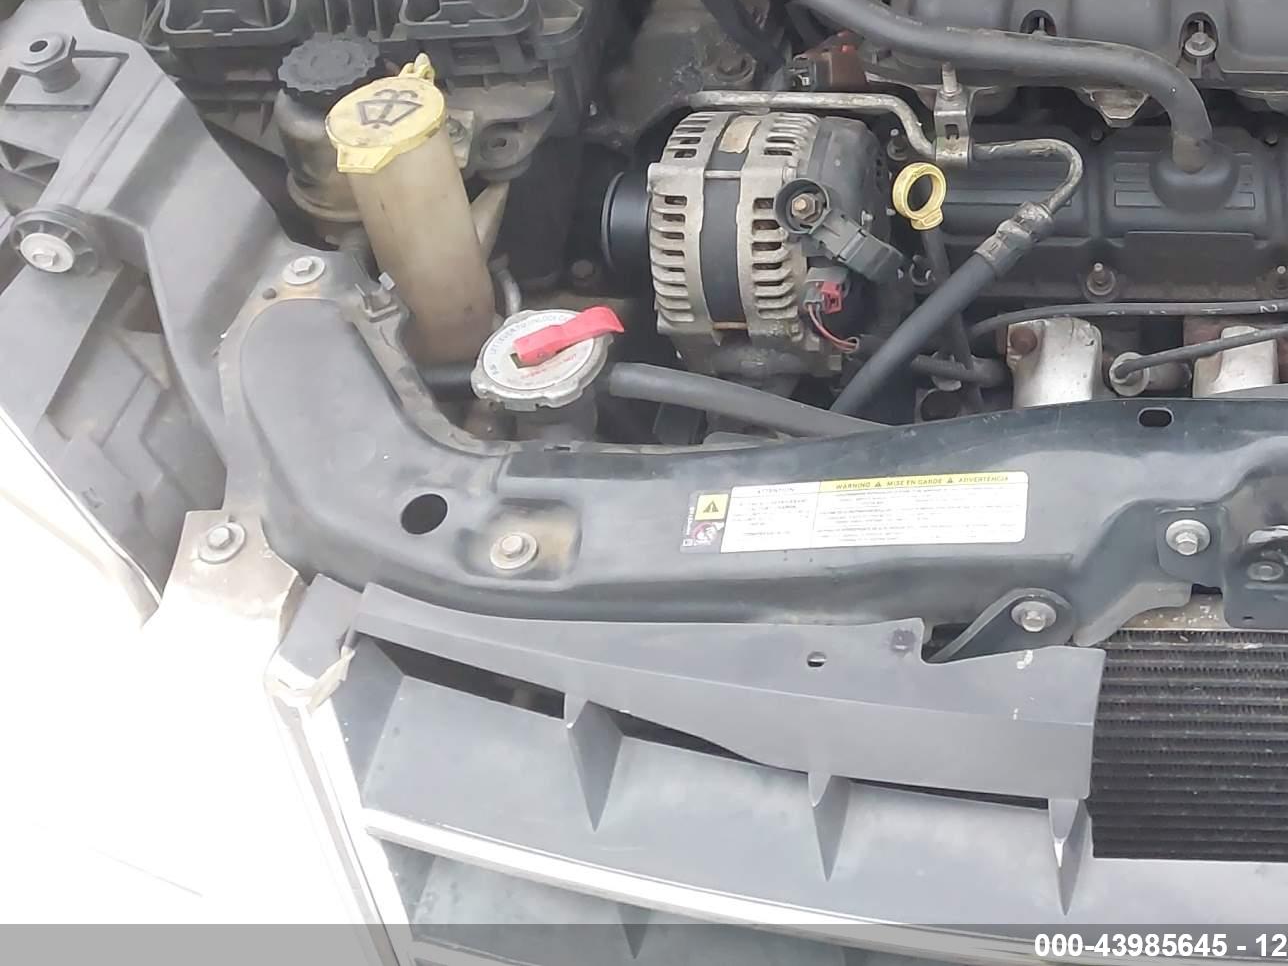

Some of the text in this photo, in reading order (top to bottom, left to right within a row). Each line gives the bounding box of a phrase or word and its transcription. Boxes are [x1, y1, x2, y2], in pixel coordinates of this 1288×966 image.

[835, 482, 871, 490] WARNING
[886, 479, 904, 487] MISE
[917, 477, 943, 485] GARDE
